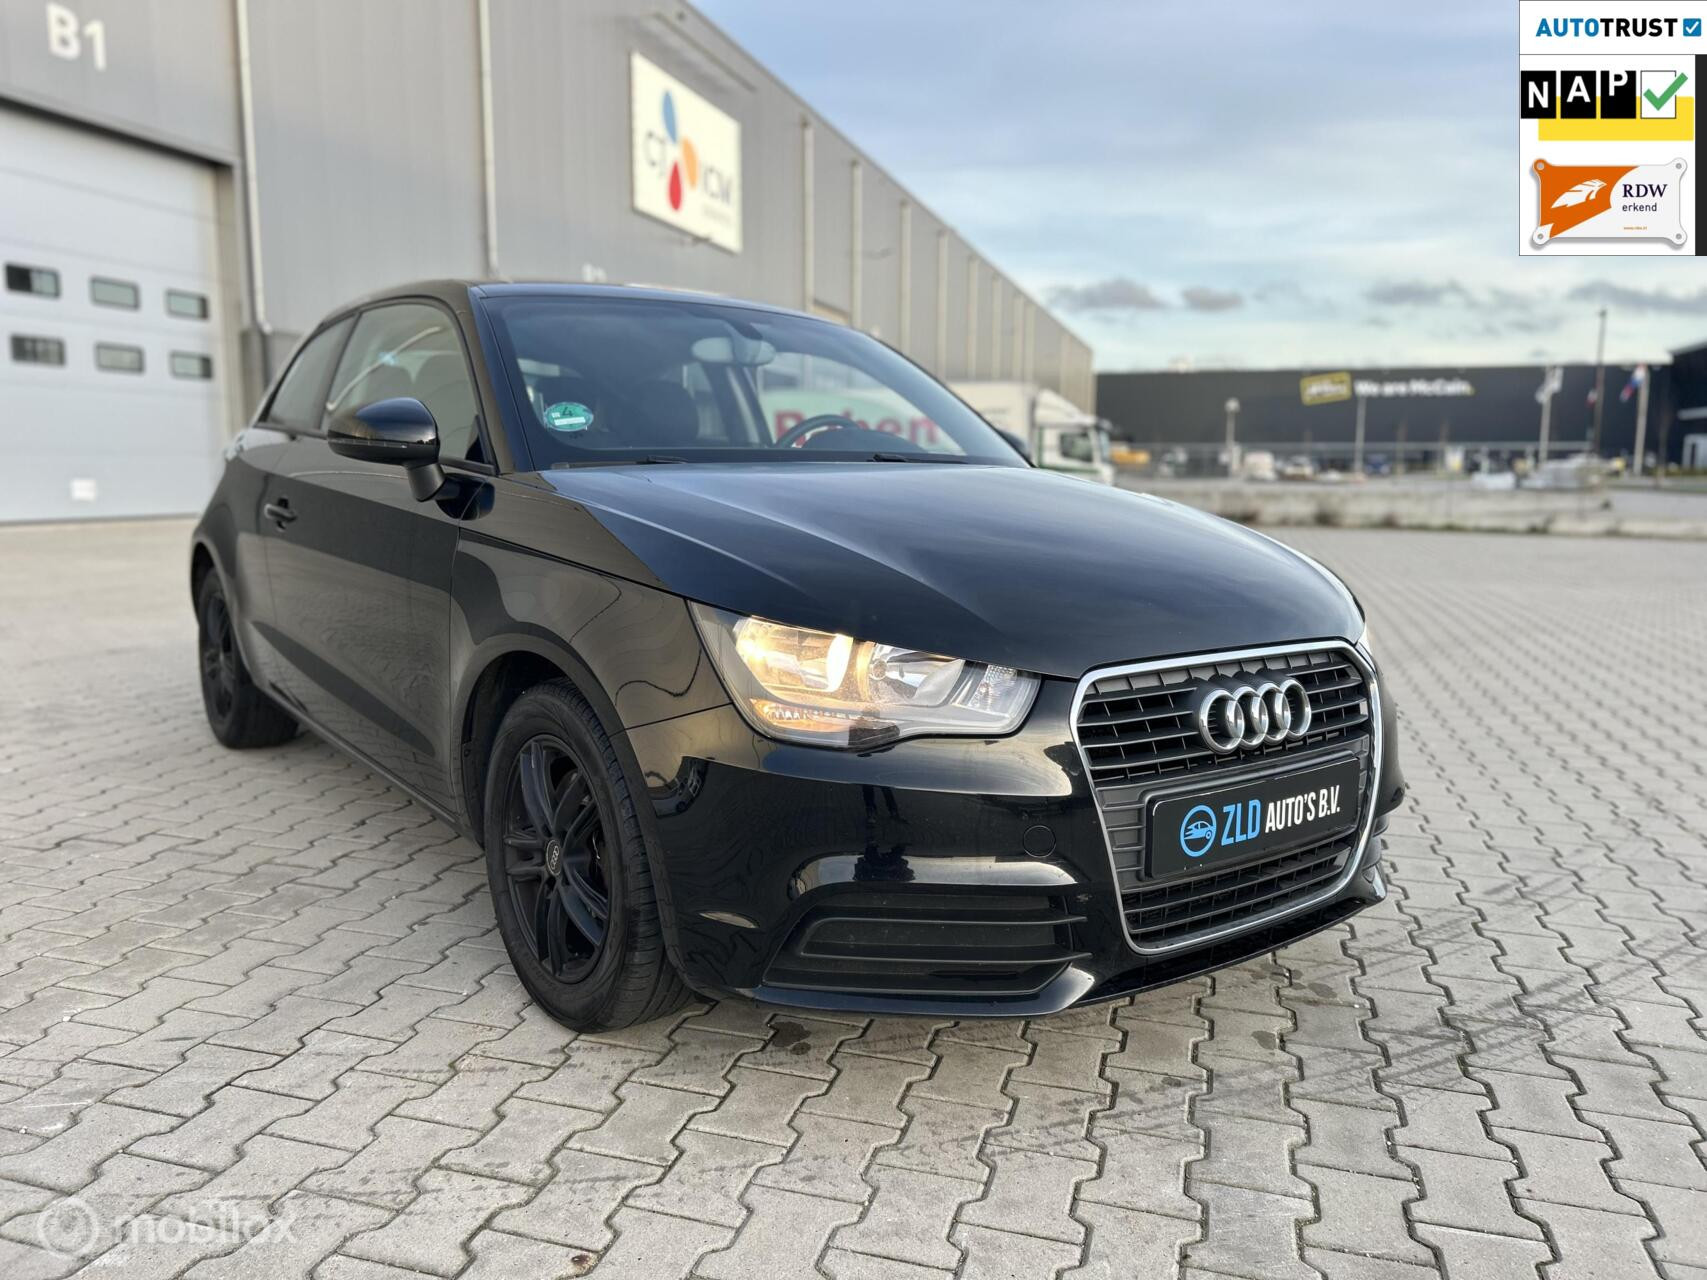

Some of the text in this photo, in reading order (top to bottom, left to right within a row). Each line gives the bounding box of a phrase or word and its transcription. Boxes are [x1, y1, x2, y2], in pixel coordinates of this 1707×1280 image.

[47, 3, 107, 71] B1
[1220, 785, 1341, 846] ZLD AUTO'S B.V.
